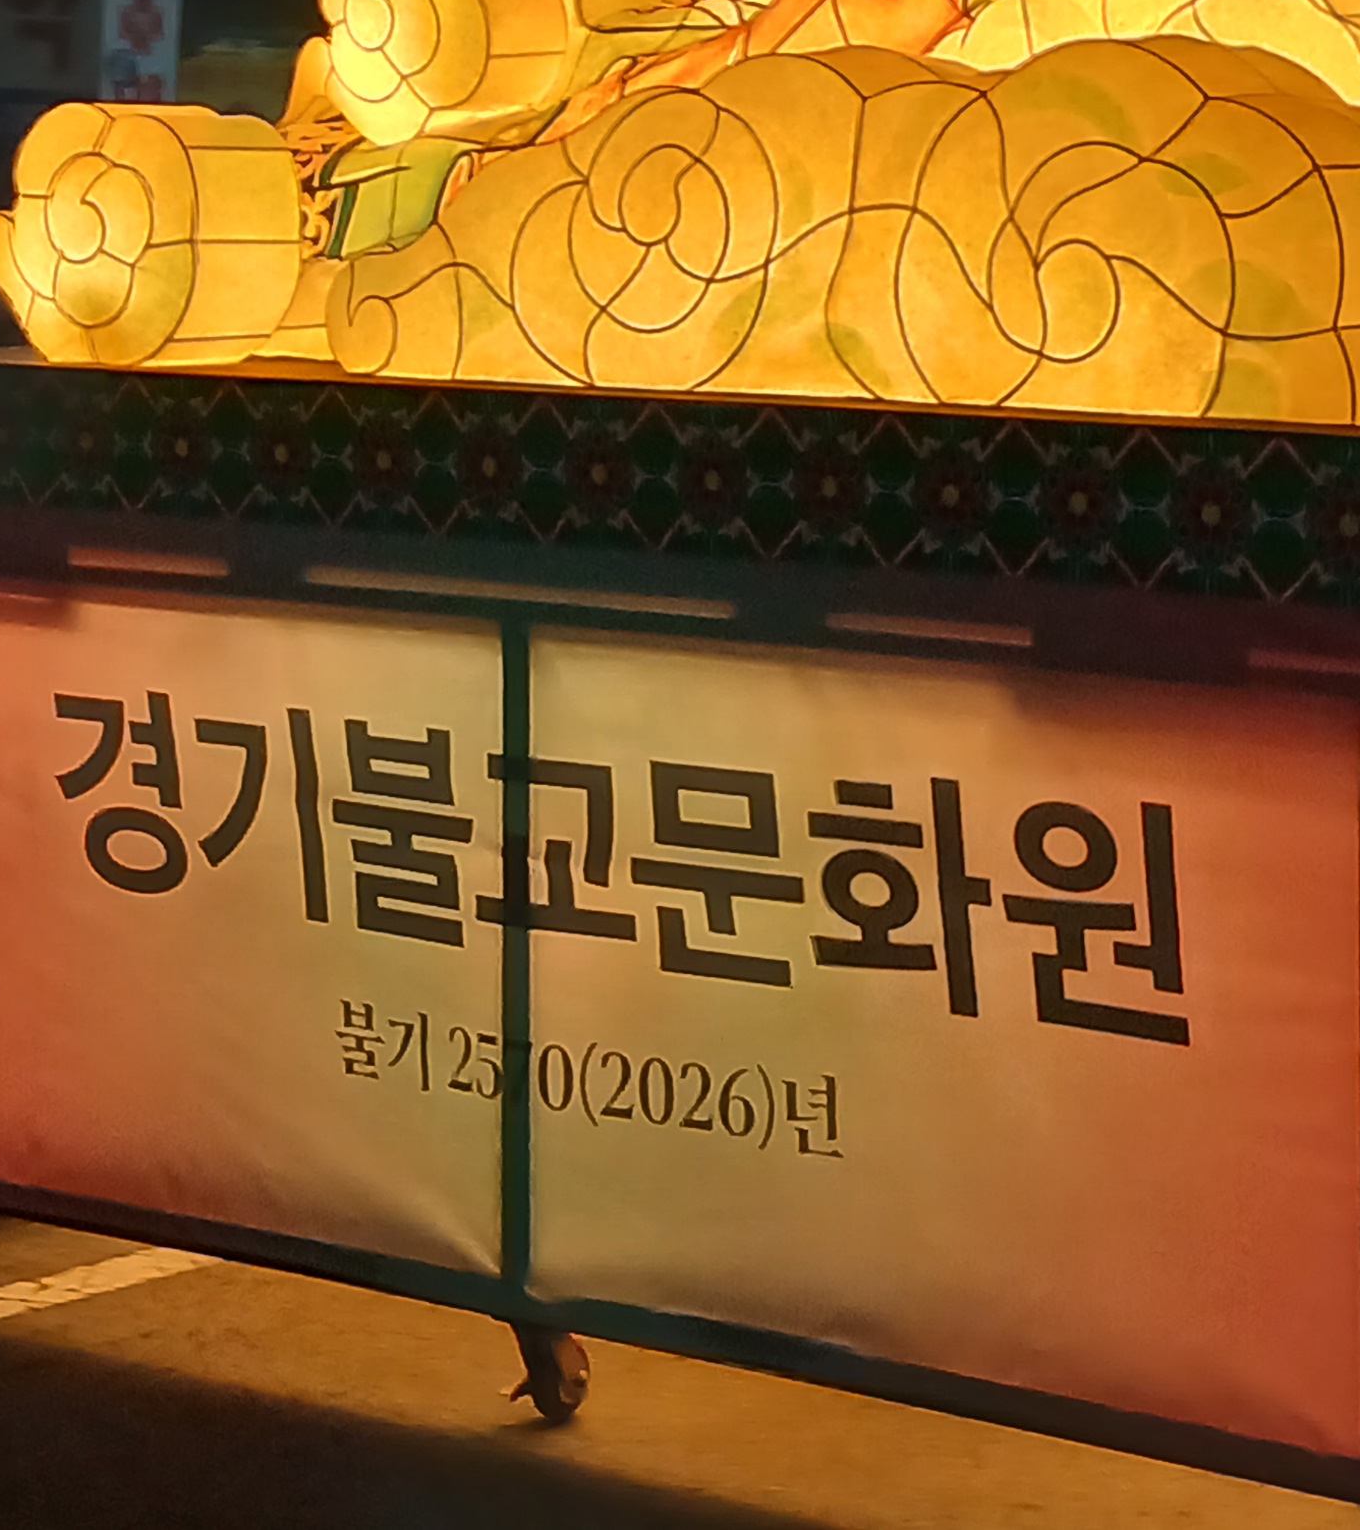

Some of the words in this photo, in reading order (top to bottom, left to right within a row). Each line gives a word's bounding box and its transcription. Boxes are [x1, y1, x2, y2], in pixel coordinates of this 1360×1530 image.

[52, 689, 1192, 1047] 경기불교문화원
[334, 998, 433, 1092] 불기
[446, 1023, 845, 1159] 250(2026)년
